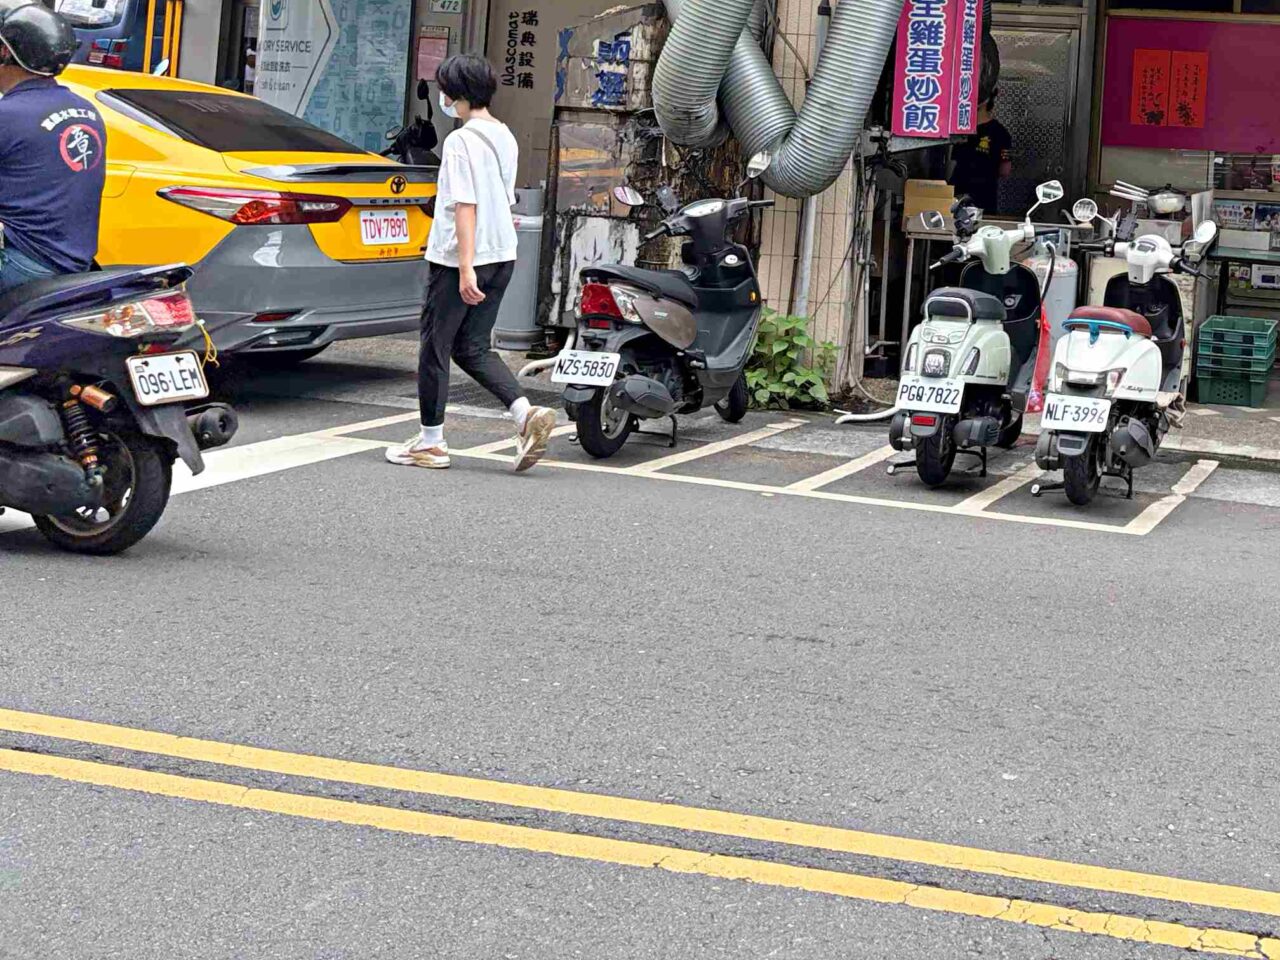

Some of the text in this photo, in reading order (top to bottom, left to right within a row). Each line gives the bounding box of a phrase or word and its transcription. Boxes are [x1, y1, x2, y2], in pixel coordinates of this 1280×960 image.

[440, 0, 460, 11] 472
[275, 40, 312, 53] SERVICE
[501, 10, 519, 87] Wascomat
[516, 9, 539, 90] 瑞典設備
[555, 358, 615, 379] NZS-5830
[899, 383, 961, 406] PGQ-7822
[1044, 405, 1106, 425] NLF-3996
